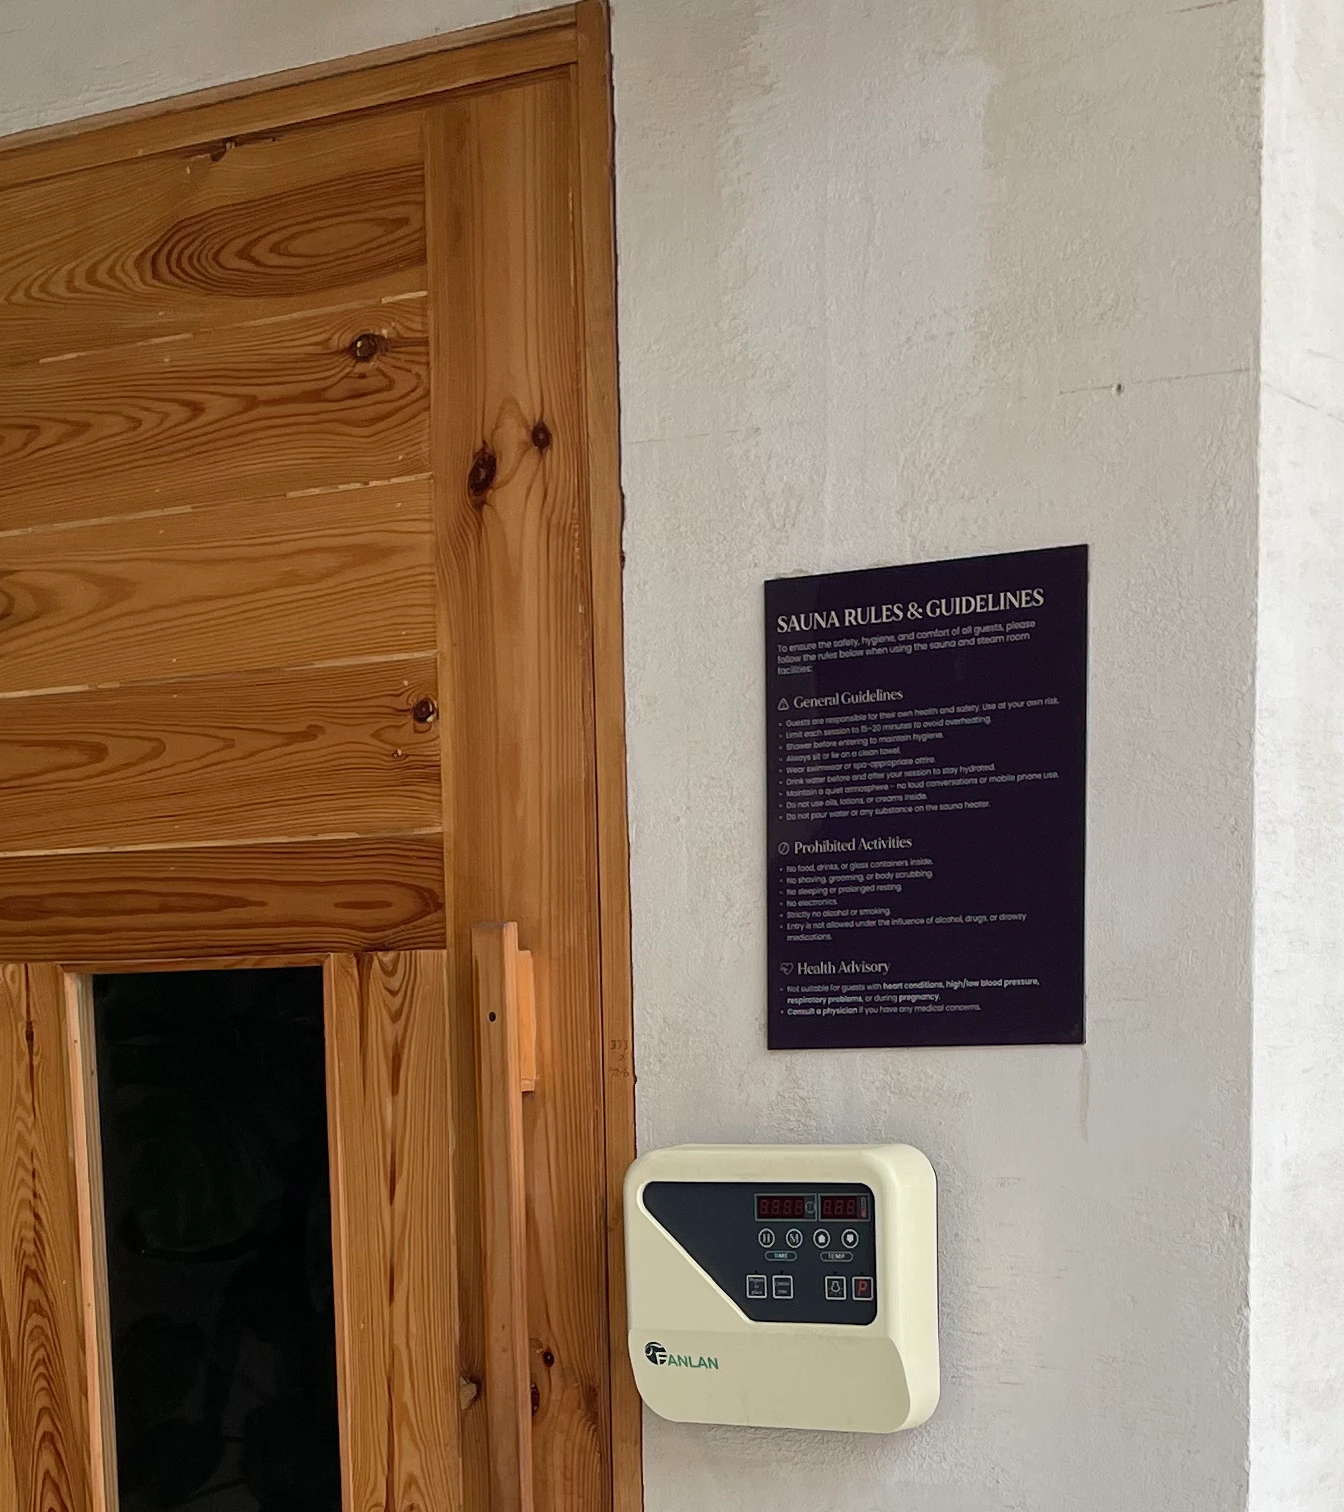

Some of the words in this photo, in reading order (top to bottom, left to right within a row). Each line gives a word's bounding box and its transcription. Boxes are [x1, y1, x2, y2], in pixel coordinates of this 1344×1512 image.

[776, 610, 840, 632] SAUNA
[844, 603, 903, 626] RULES
[906, 601, 922, 619] &
[925, 587, 1044, 617] GUIDELINES
[777, 644, 787, 652] To
[897, 631, 914, 641] and
[950, 625, 960, 636] of
[961, 625, 972, 634] all
[802, 653, 816, 661] the
[913, 642, 927, 650] the
[957, 637, 975, 646] and
[793, 692, 839, 708] General
[840, 688, 903, 704] Guidelines
[939, 705, 955, 714] and
[997, 701, 1006, 709] at
[868, 736, 877, 744] to
[851, 772, 866, 780] and
[785, 801, 796, 809] Do
[796, 800, 809, 808] not
[785, 812, 796, 820] Do
[859, 809, 873, 817] any
[794, 837, 855, 854] Prohibited
[858, 835, 912, 850] Activities
[805, 921, 811, 929] is
[925, 915, 933, 924] of
[797, 961, 835, 974] Health
[837, 960, 889, 975] Advisory
[829, 983, 840, 991] for
[840, 983, 865, 993] guests
[903, 980, 945, 989] conditions,
[945, 977, 979, 990] high/low
[980, 978, 1002, 987] blood
[1003, 978, 1039, 988] pressure,
[786, 995, 826, 1005] respiratory
[873, 994, 897, 1003] during
[898, 993, 940, 1002] pregnancy.
[864, 1006, 878, 1015] you
[898, 1006, 913, 1014] any
